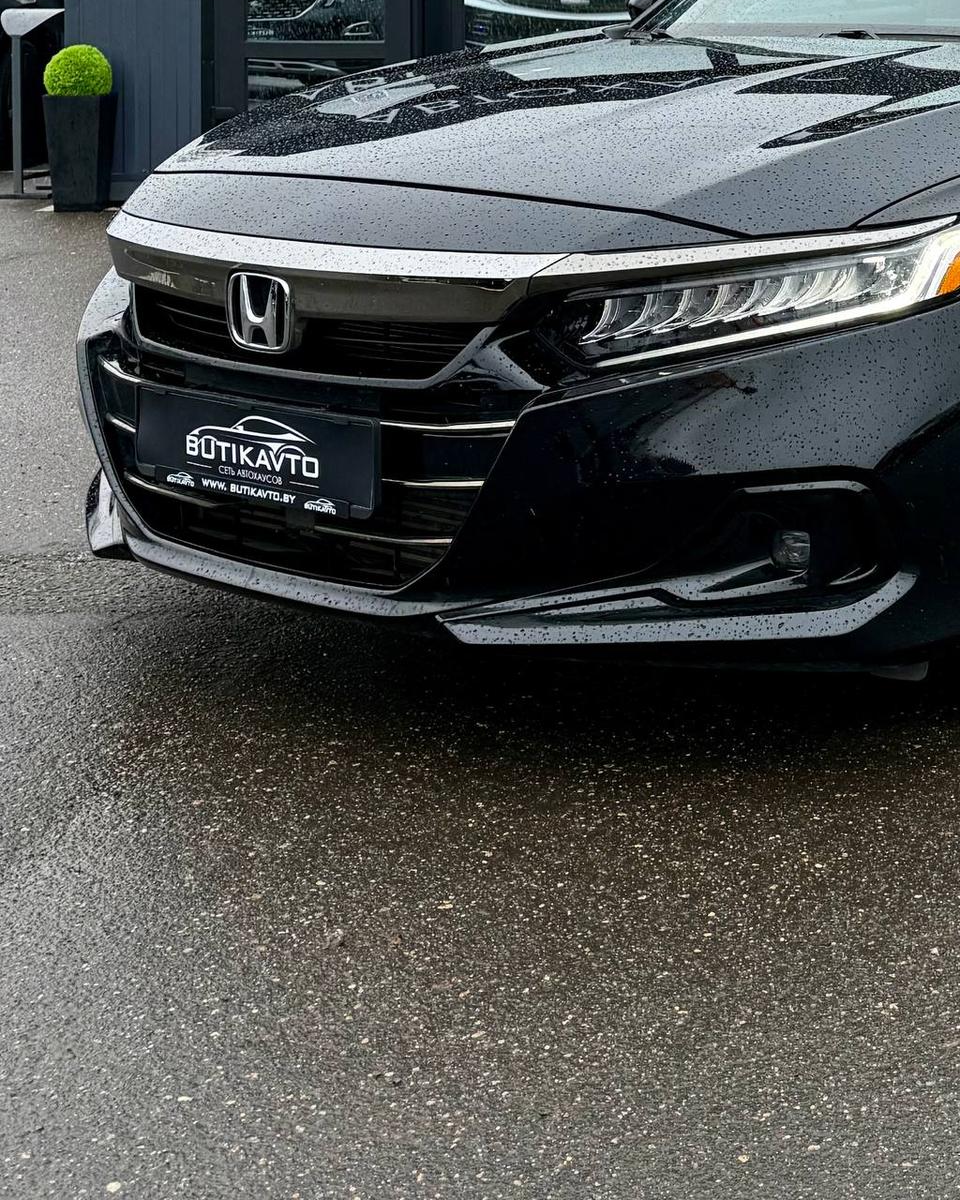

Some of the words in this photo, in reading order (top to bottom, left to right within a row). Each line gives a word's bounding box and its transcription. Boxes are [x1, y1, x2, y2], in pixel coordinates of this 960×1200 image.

[186, 435, 319, 479] BUTIKAVTO
[218, 465, 235, 476] СЕТЬ
[237, 468, 283, 485] АВТОХАУСОВ
[201, 478, 227, 491] WWW.
[230, 484, 296, 504] BUTIKAVTO.BY
